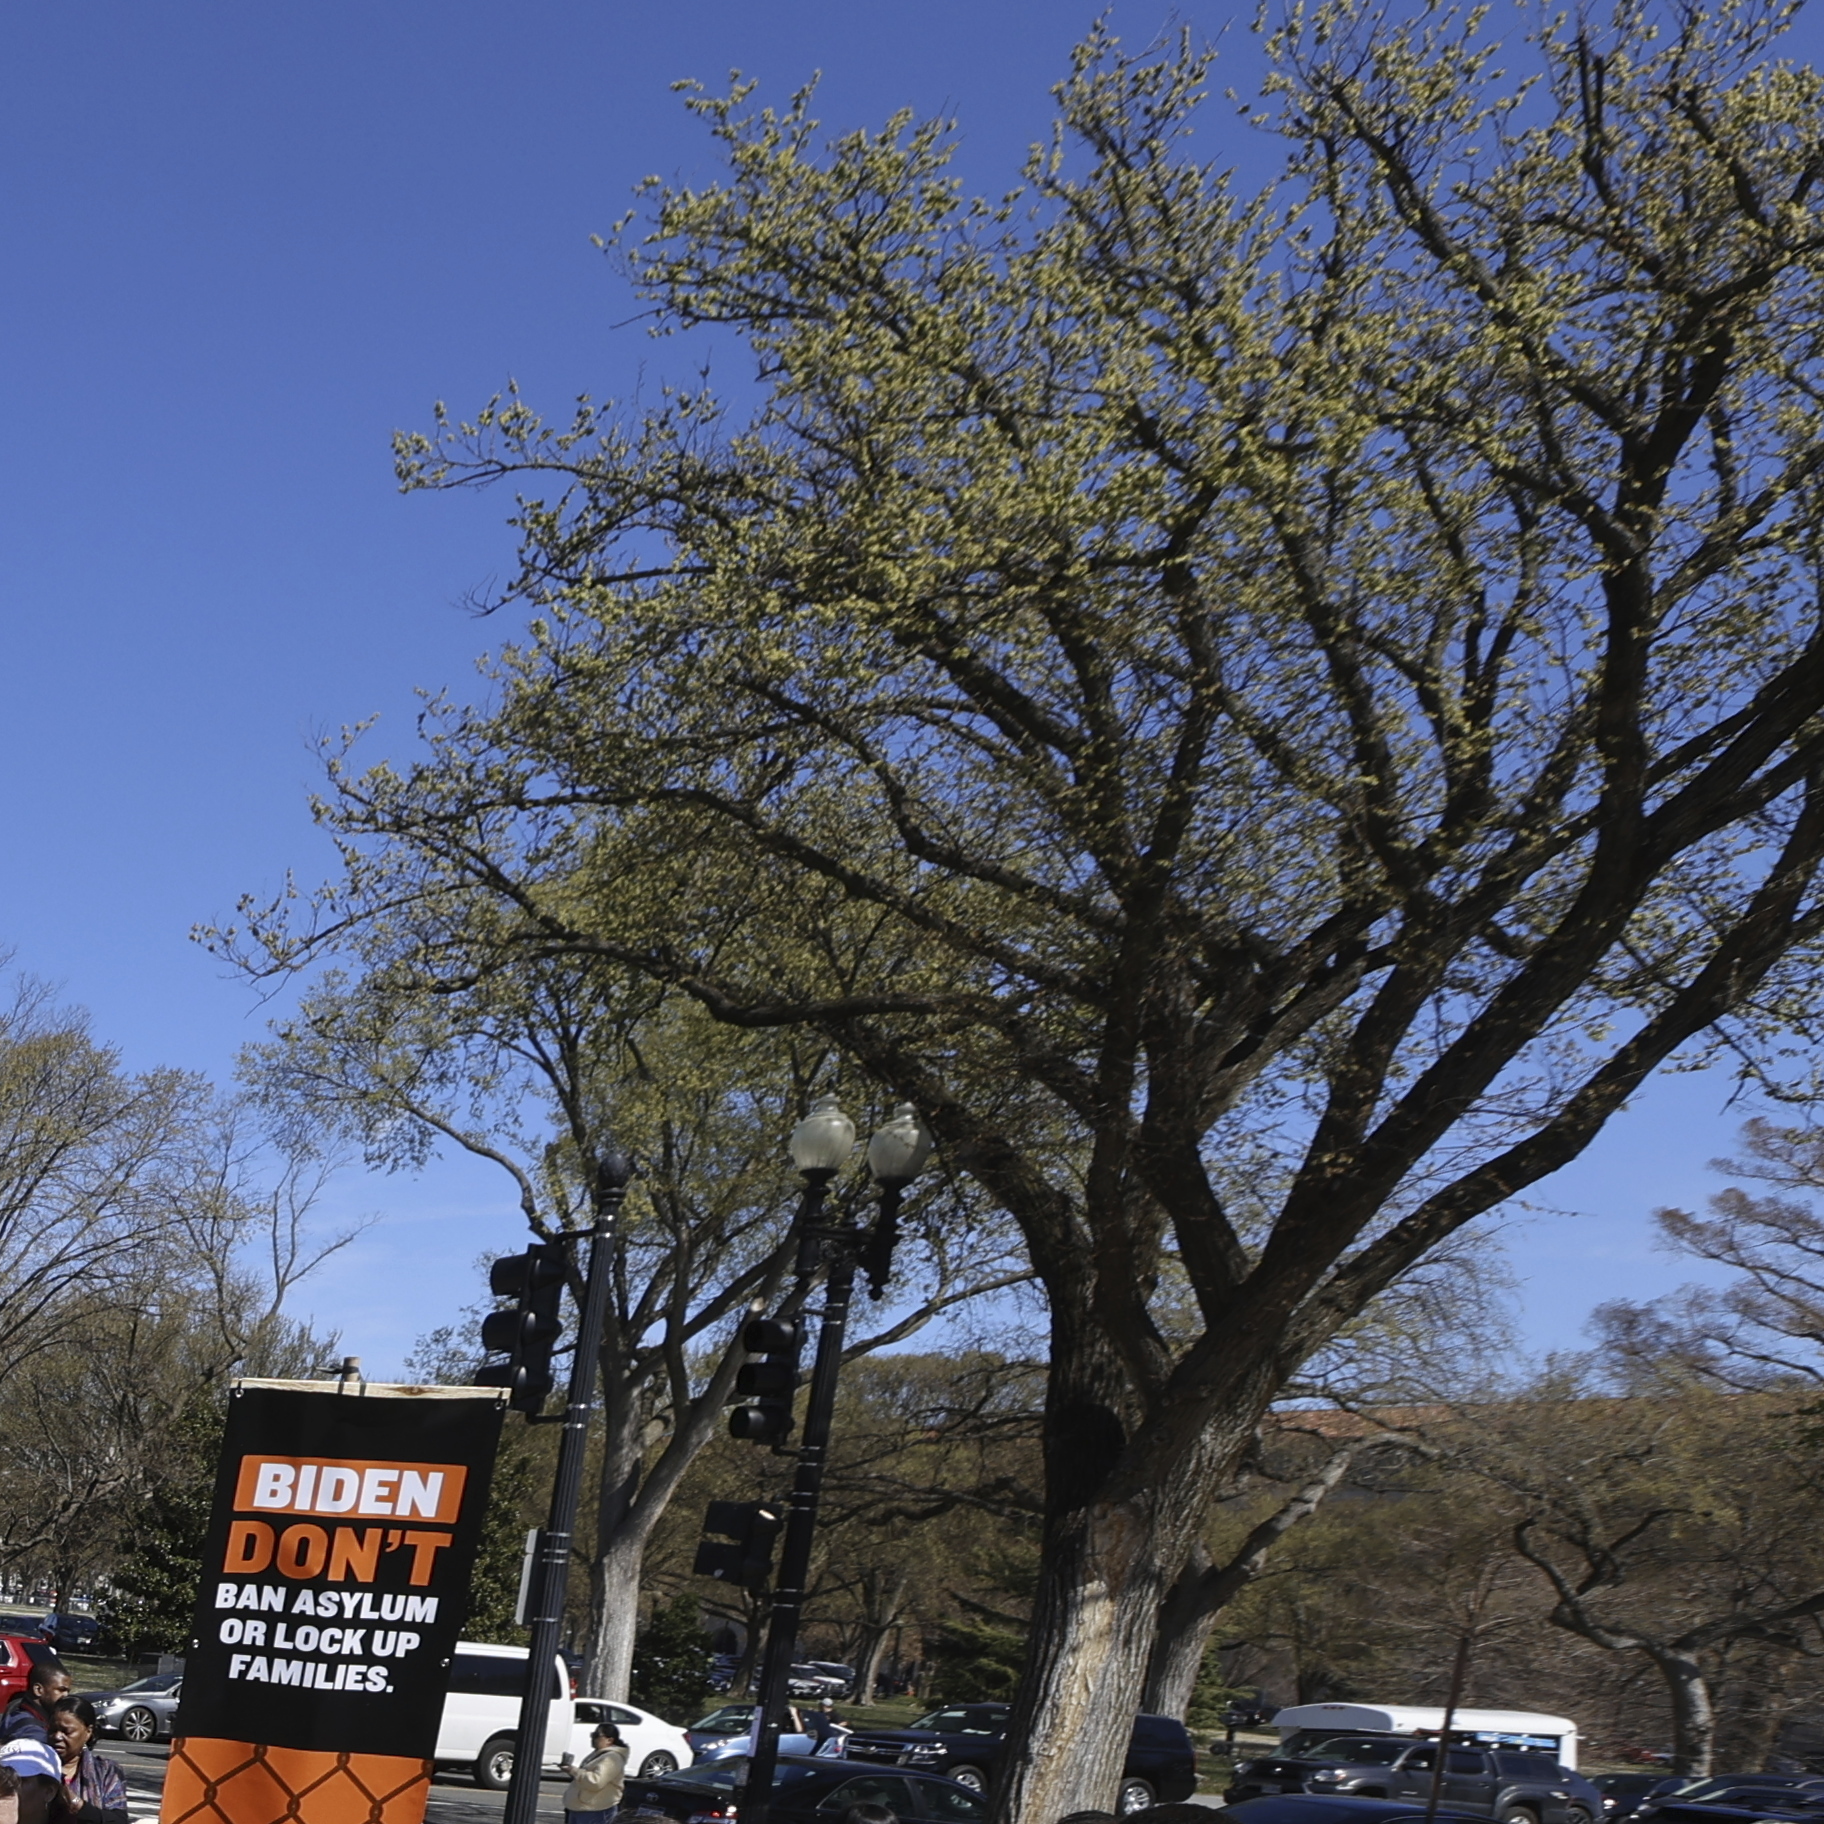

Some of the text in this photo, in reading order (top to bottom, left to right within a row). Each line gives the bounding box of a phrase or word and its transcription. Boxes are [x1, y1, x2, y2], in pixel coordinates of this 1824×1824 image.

[253, 1463, 444, 1517] BIDEN
[214, 1583, 439, 1624] BAN ASYLUM
[219, 1618, 420, 1657] OR LOCK UP
[228, 1653, 394, 1693] FAMILIES.
